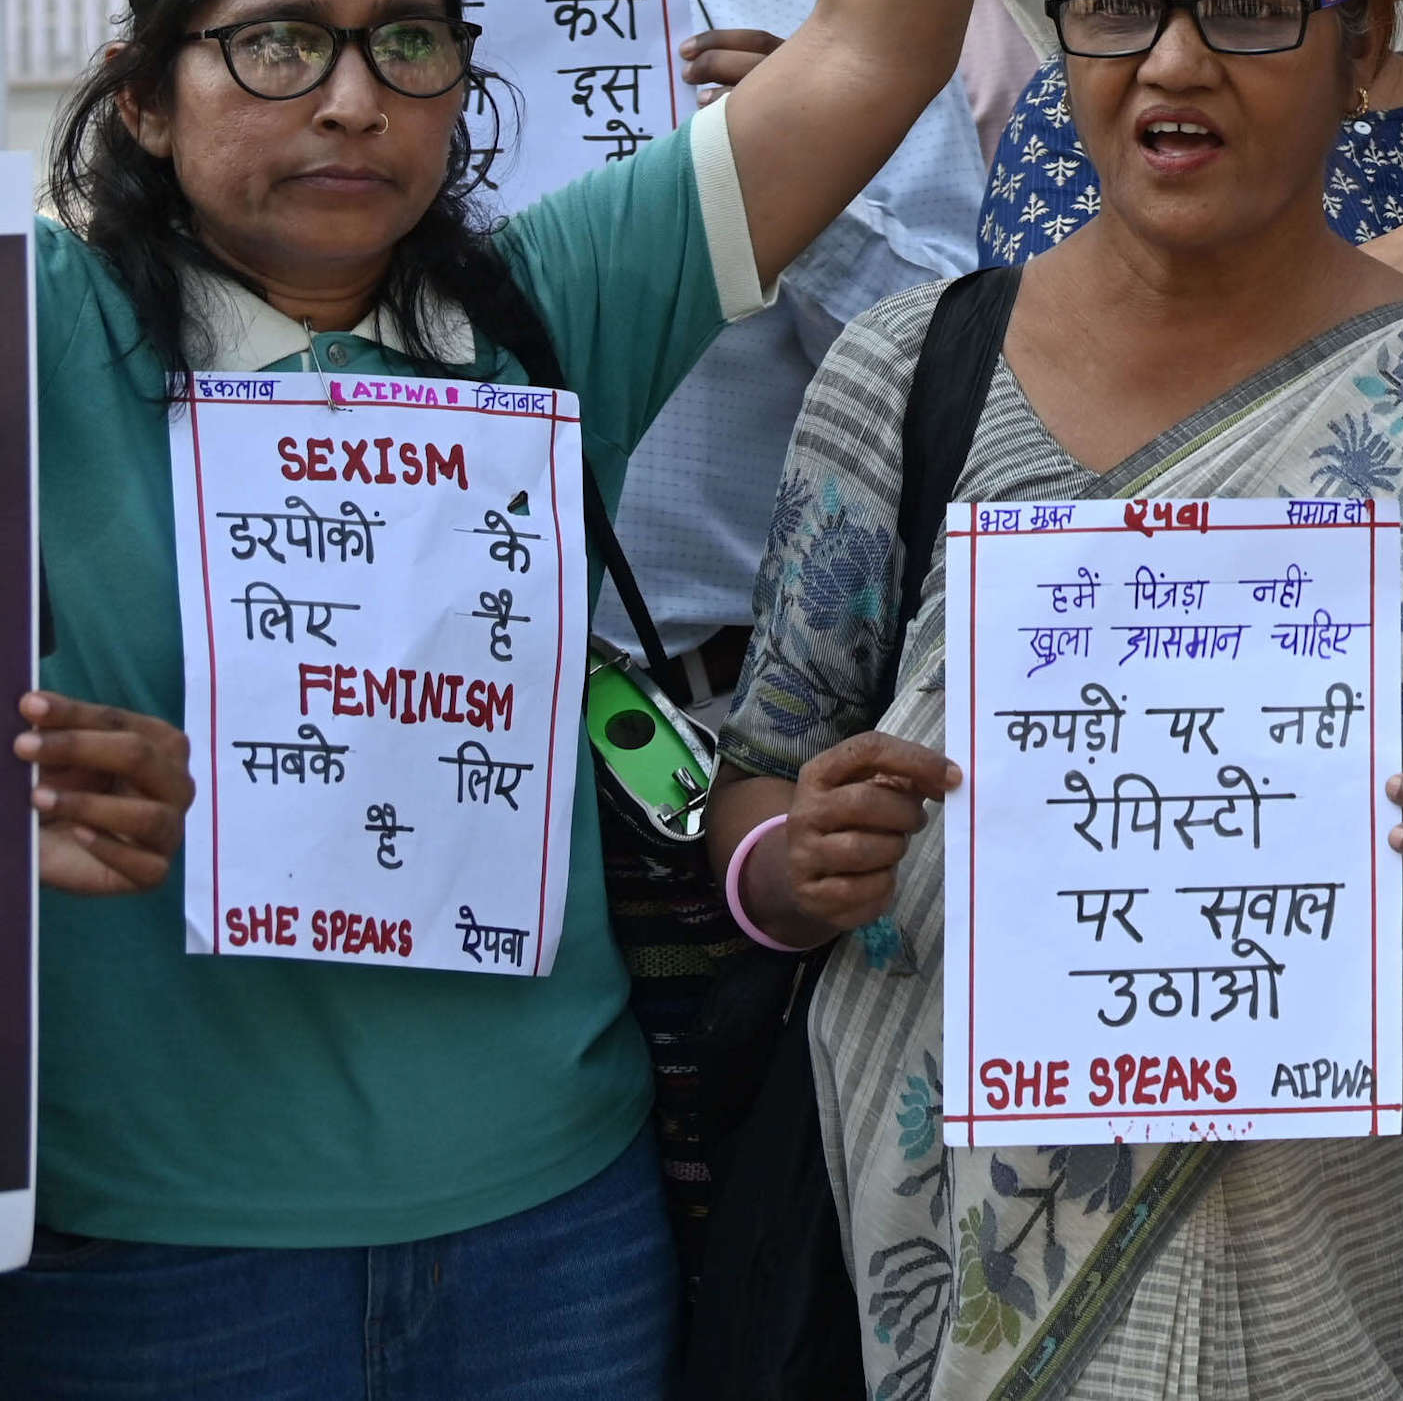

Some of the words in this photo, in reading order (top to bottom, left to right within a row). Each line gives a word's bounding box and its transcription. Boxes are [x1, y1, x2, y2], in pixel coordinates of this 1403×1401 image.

[557, 65, 653, 116] इस
[353, 382, 437, 406] AIPWA
[277, 436, 468, 491] SEXISM
[472, 509, 543, 574] के
[1037, 567, 1102, 613] हमें
[1238, 564, 1313, 609] नहीं
[230, 581, 362, 647] लिए
[471, 588, 531, 662] है
[1018, 625, 1094, 678] खुला
[1110, 623, 1252, 666] आसमान
[1270, 608, 1371, 659] चाहिए
[298, 662, 514, 733] FEMINISM
[1145, 707, 1225, 755] पर
[1261, 682, 1366, 748] नहीं
[232, 723, 351, 786] सबके
[438, 740, 535, 811] लिए
[364, 802, 415, 870] है
[226, 903, 299, 947] SHE
[312, 909, 413, 957] SPEAKS
[455, 905, 531, 968] ऐपवा
[1057, 887, 1150, 943] पर
[1175, 882, 1346, 941] सवाल
[1068, 938, 1286, 1027] उठाओ
[980, 1057, 1070, 1111] SHE
[1089, 1054, 1238, 1106] SPEAKS
[1271, 1058, 1376, 1100] AIPWA
